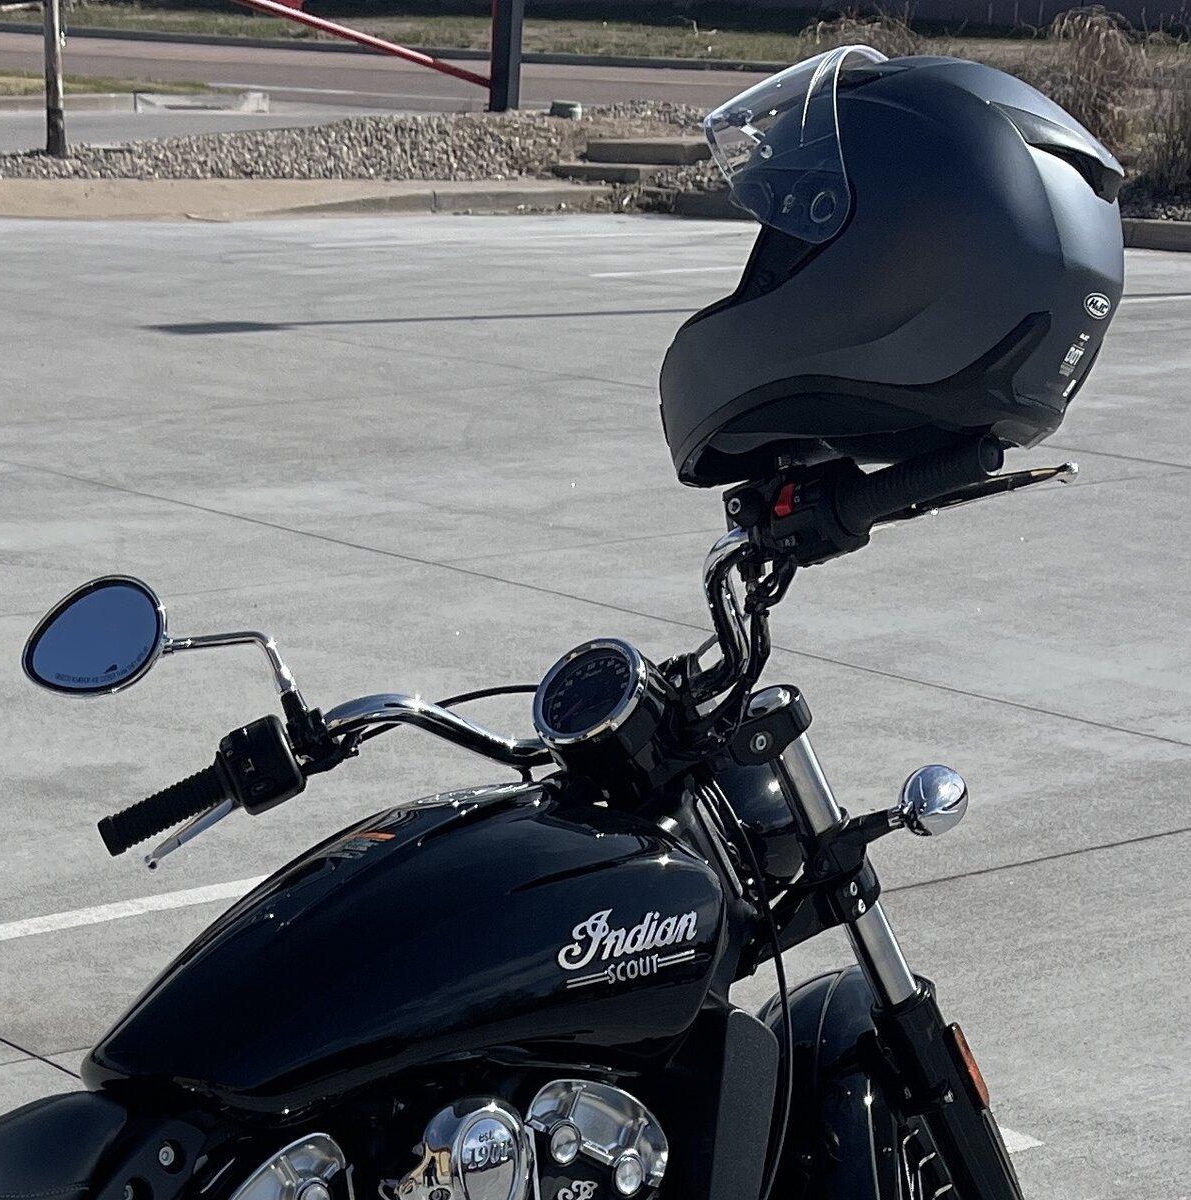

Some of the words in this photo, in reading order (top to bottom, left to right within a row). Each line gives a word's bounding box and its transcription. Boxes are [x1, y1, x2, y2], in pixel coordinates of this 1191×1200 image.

[1087, 297, 1109, 315] HJC
[557, 908, 698, 970] Indian
[607, 953, 659, 985] SCOUT
